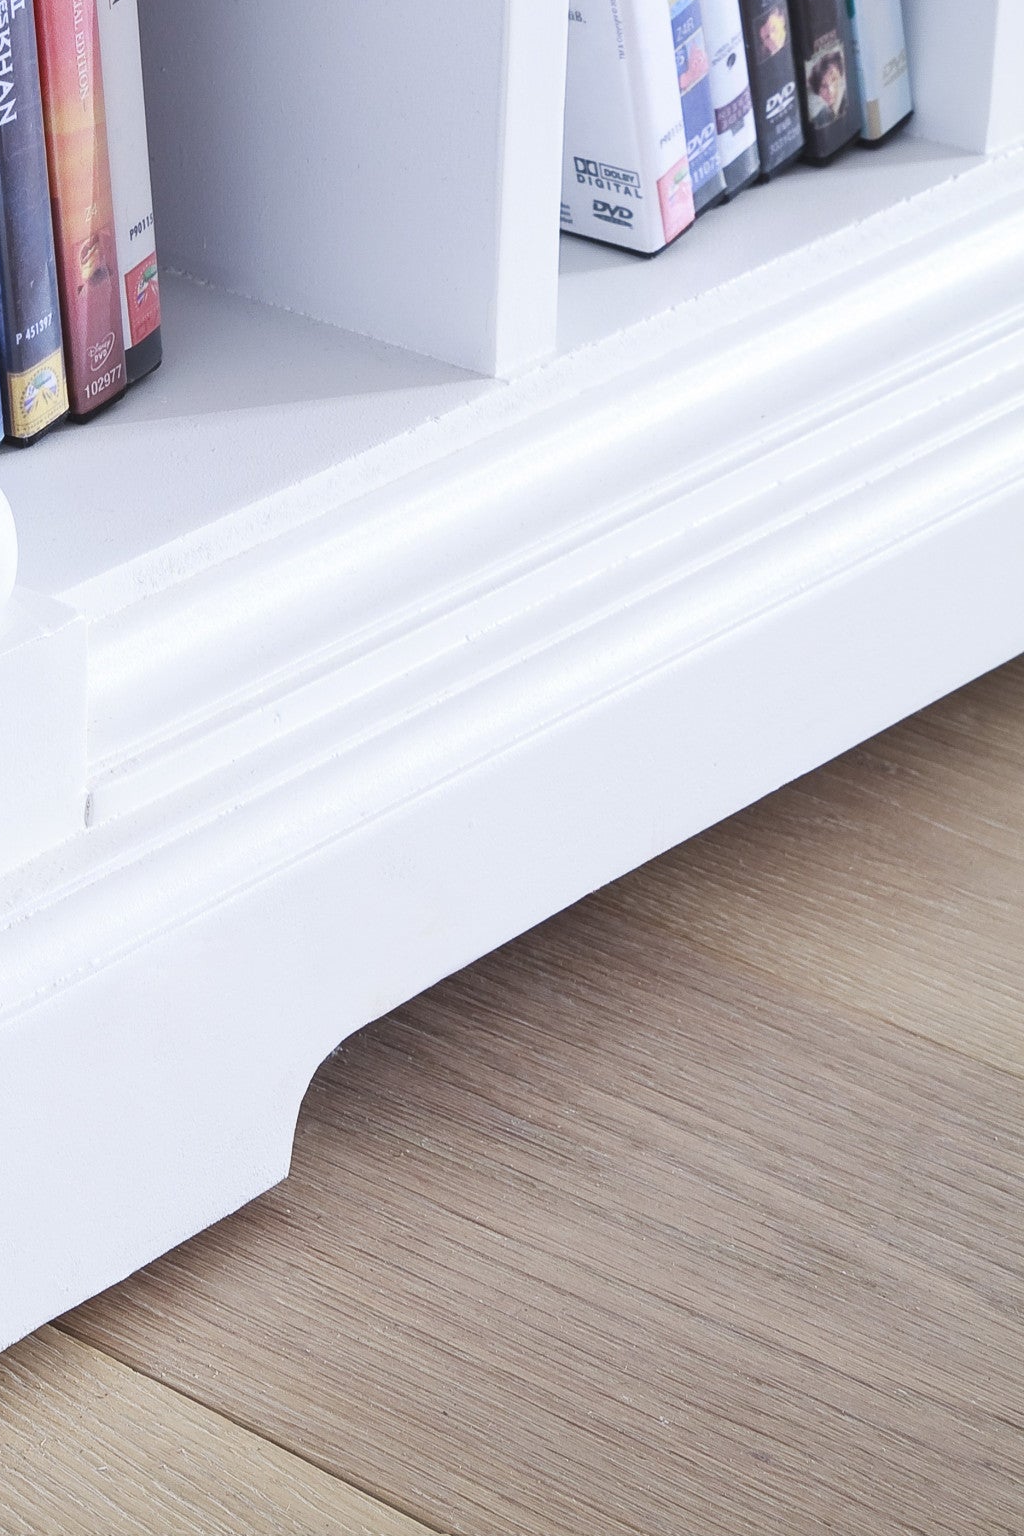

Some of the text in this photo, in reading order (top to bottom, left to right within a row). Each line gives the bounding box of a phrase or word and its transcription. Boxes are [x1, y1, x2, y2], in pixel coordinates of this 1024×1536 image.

[74, 30, 90, 101] EDITION
[766, 81, 796, 113] DVD
[687, 122, 715, 155] DVD
[576, 173, 643, 199] DIGITAL
[603, 168, 635, 184] DOLBY
[593, 199, 634, 220] DVD
[25, 312, 53, 341] 451397
[85, 363, 122, 400] 102977
